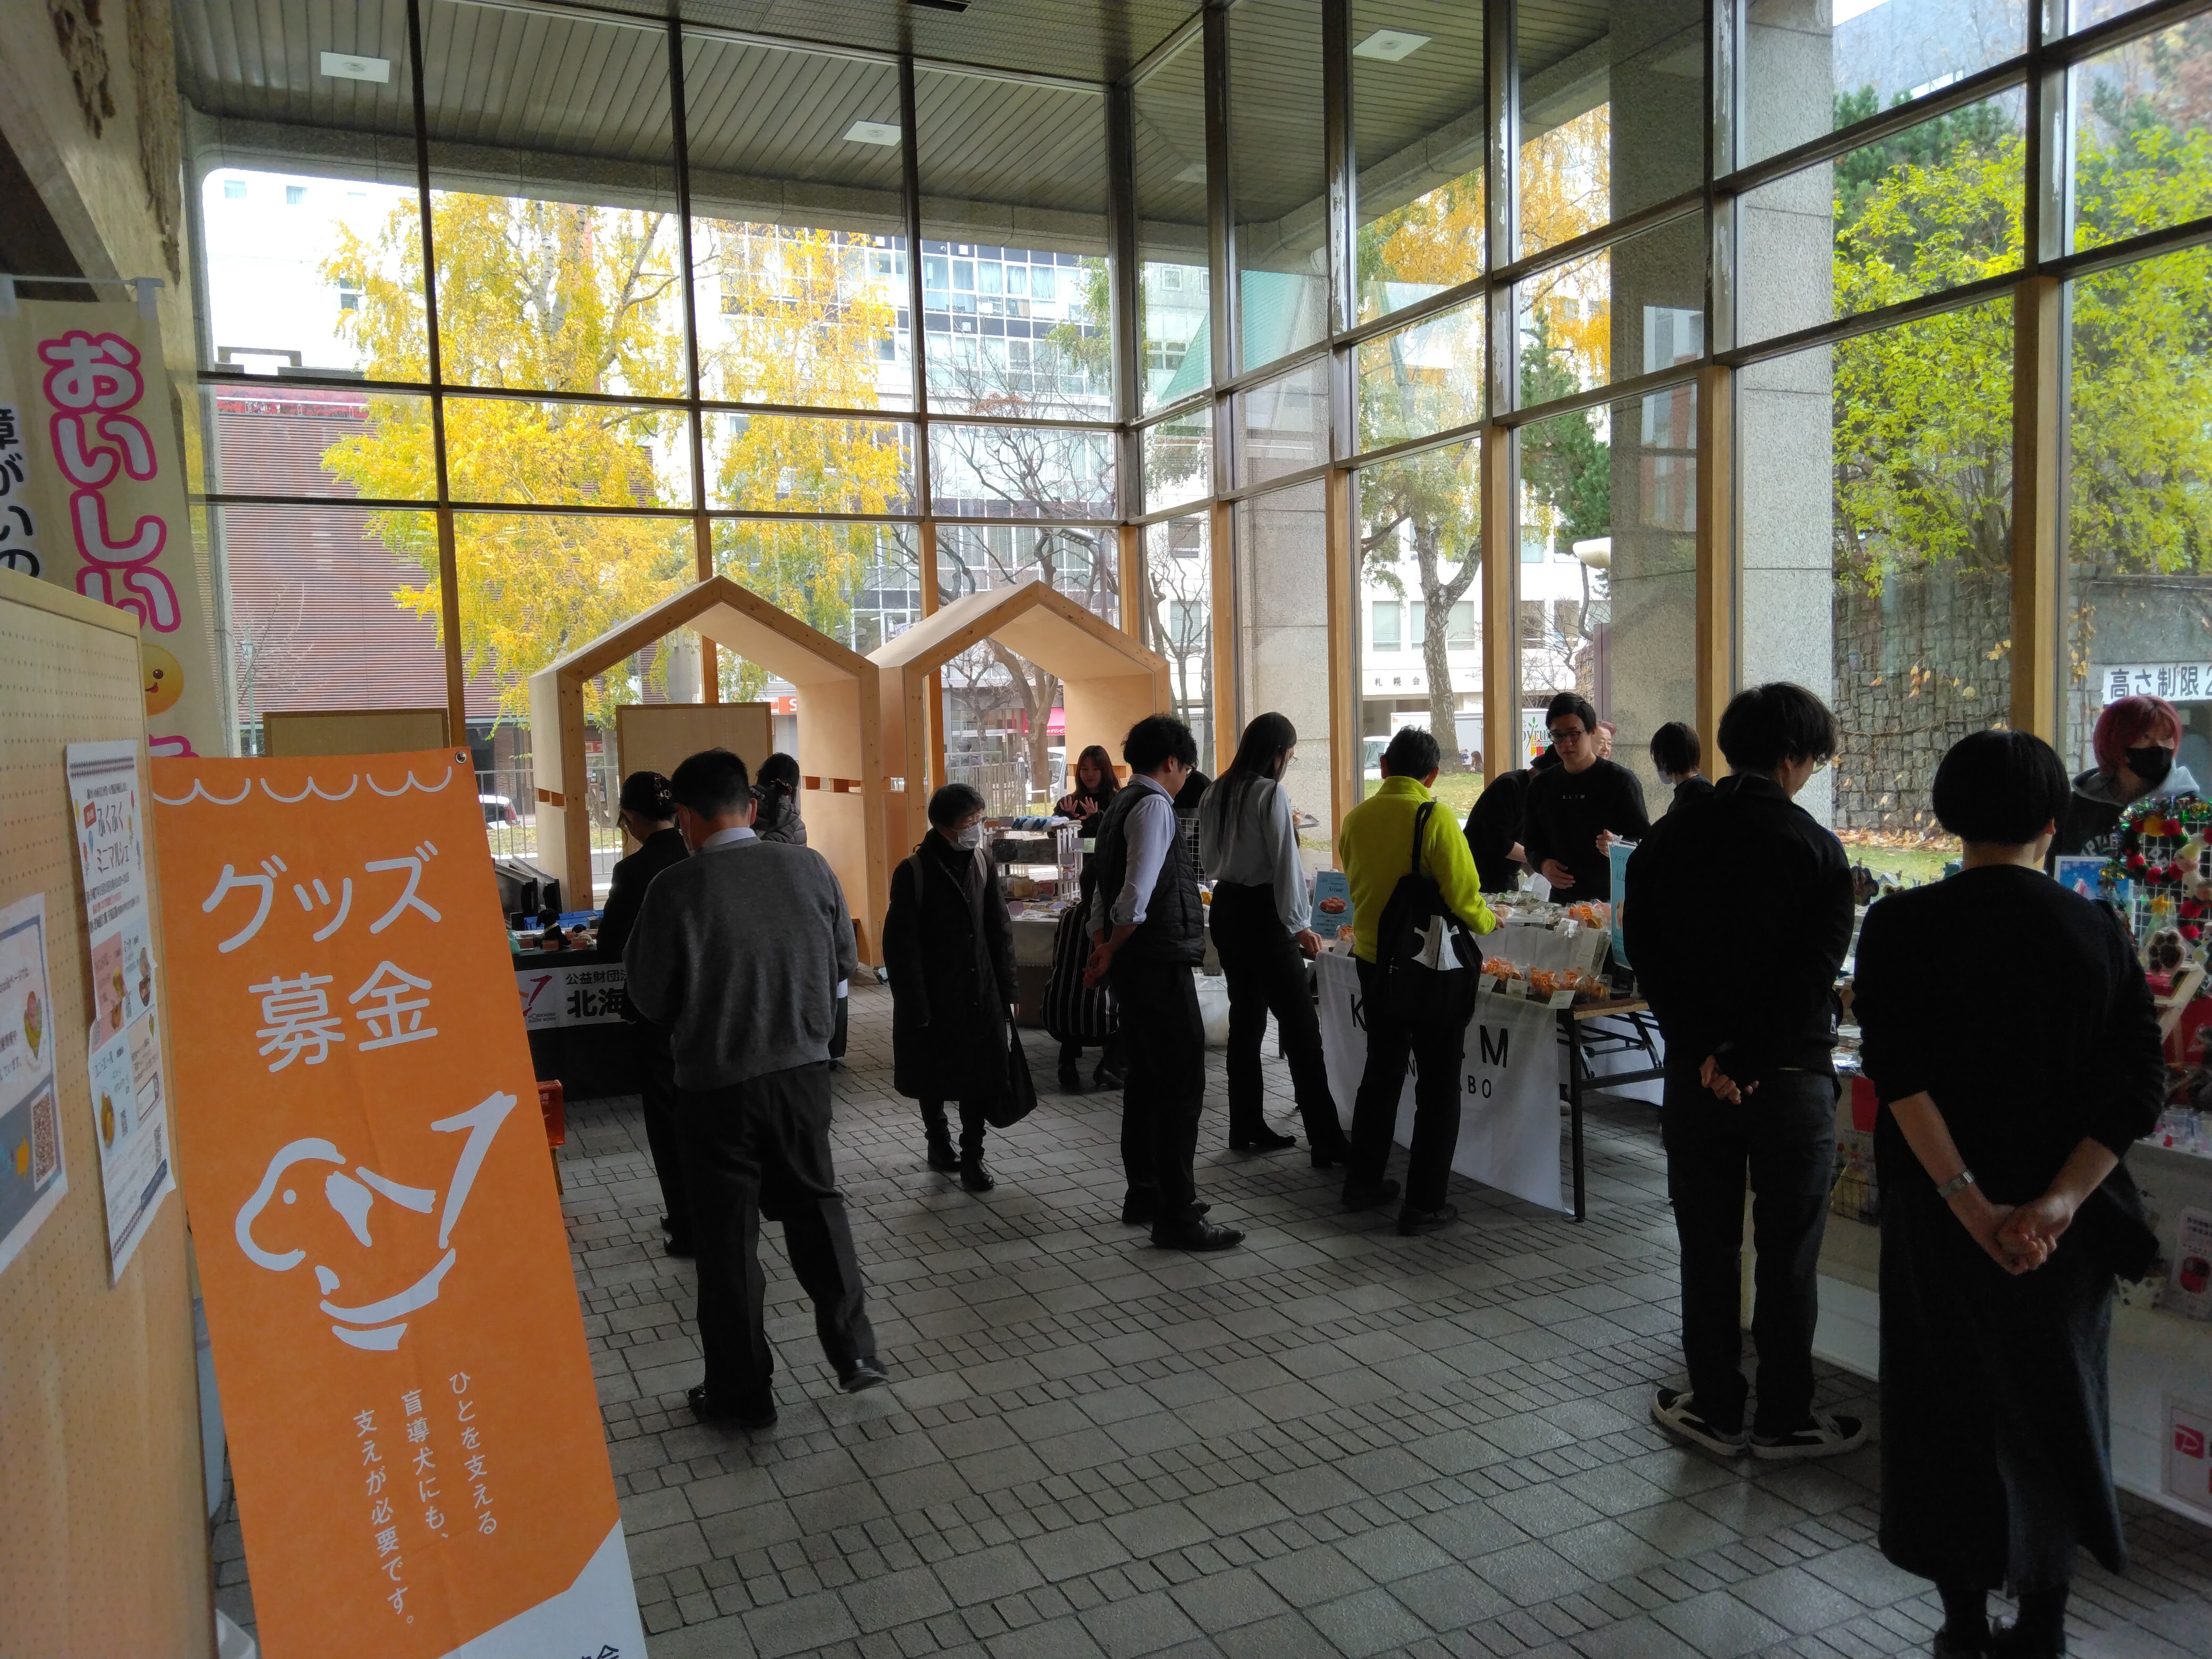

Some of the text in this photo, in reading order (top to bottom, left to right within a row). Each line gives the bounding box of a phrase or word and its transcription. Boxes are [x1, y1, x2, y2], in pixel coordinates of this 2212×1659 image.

[37, 330, 181, 632] おいしい
[202, 841, 441, 953] グッズ
[248, 960, 438, 1073] 募金
[353, 1410, 414, 1624] 支えが必要です。
[401, 1389, 448, 1538] 盲導犬にも、
[449, 1372, 497, 1535] ひとを支える
